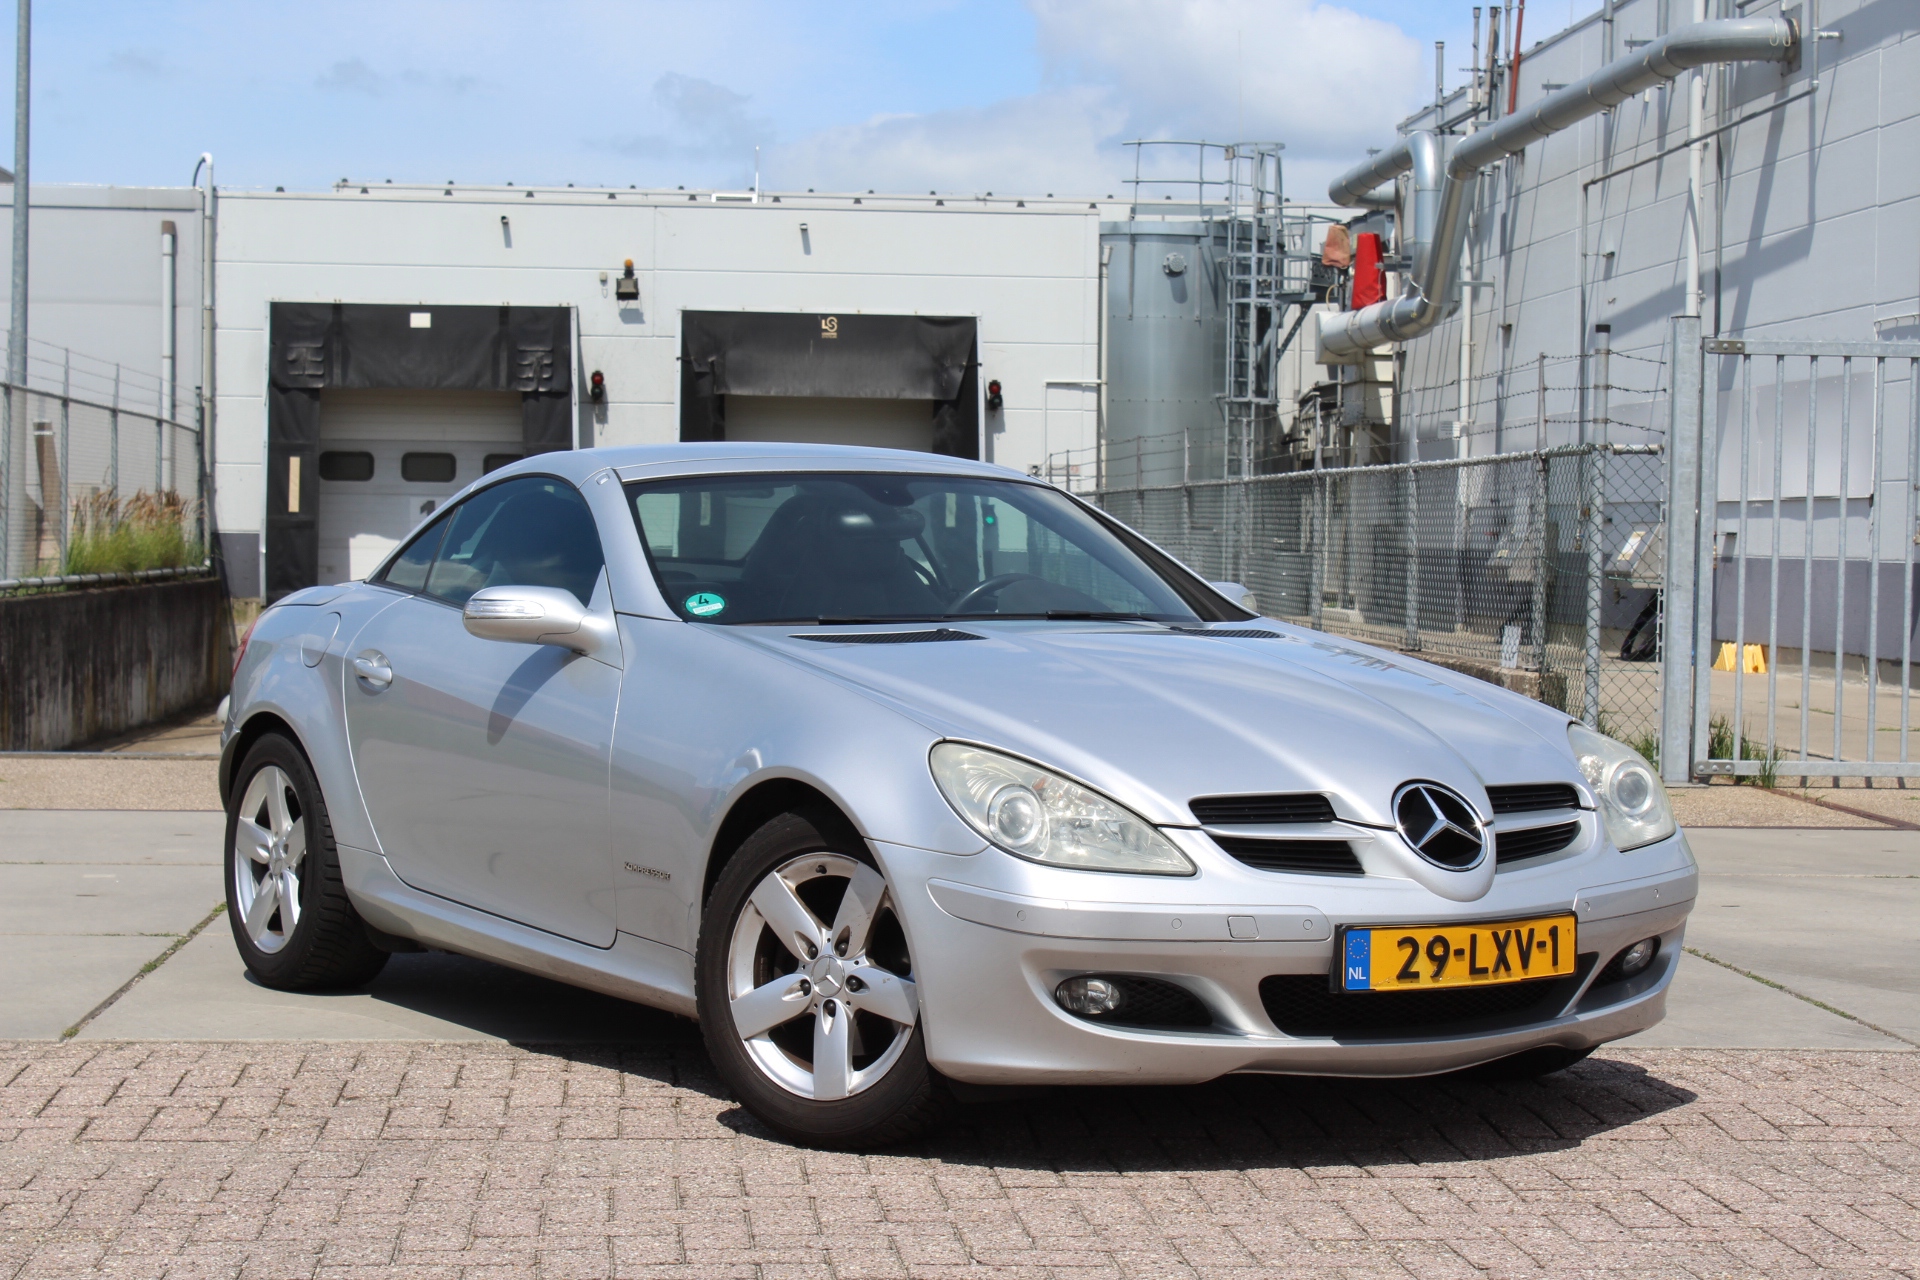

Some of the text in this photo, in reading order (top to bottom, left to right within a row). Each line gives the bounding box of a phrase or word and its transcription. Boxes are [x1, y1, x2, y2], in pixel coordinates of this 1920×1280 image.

[698, 594, 710, 605] 4
[624, 861, 671, 881] KOMPRESSOR
[1396, 925, 1559, 980] 29-LXV-1
[1348, 966, 1367, 980] NL
